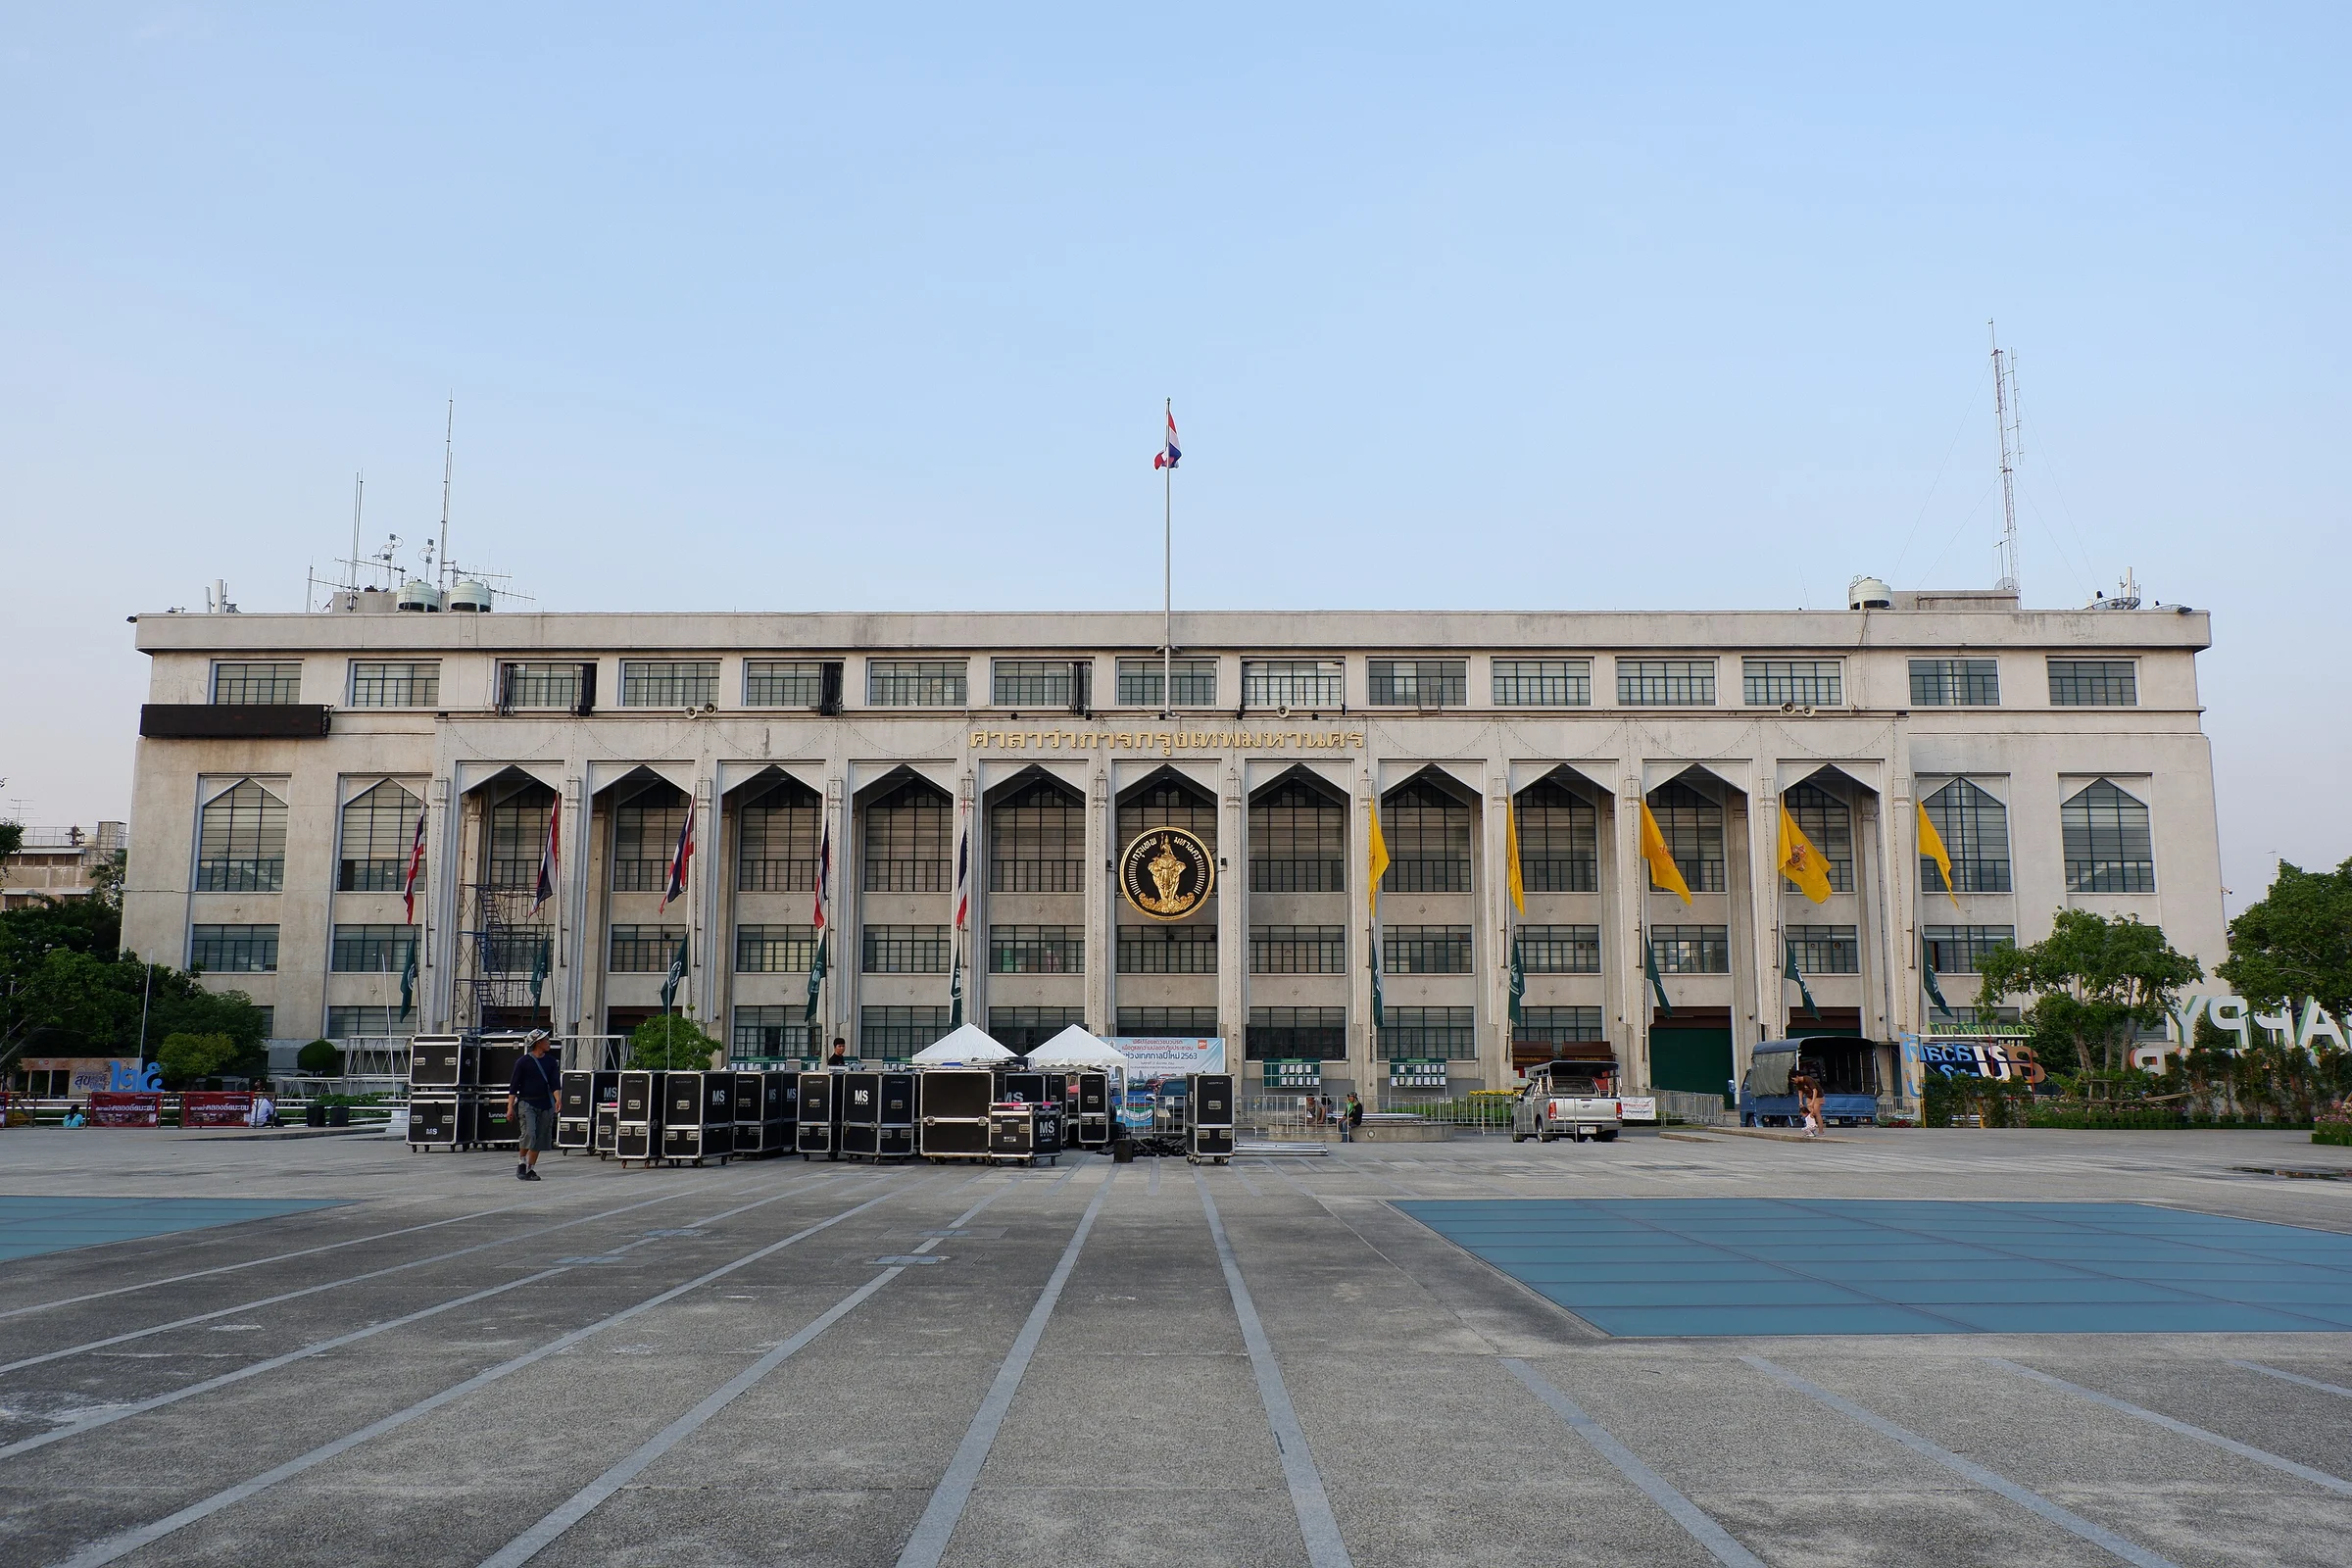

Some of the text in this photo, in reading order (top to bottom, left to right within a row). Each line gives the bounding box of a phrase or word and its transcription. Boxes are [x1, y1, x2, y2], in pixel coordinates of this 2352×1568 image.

[969, 728, 1364, 756] ศาลาว่าการกรุงเทพมหานคร
[1132, 837, 1201, 860] กรุงเทพ มหานคร
[604, 1087, 617, 1099] MS
[712, 1090, 725, 1102] MS
[768, 1088, 777, 1101] MS
[786, 1088, 797, 1100] MS
[855, 1089, 868, 1102] MS
